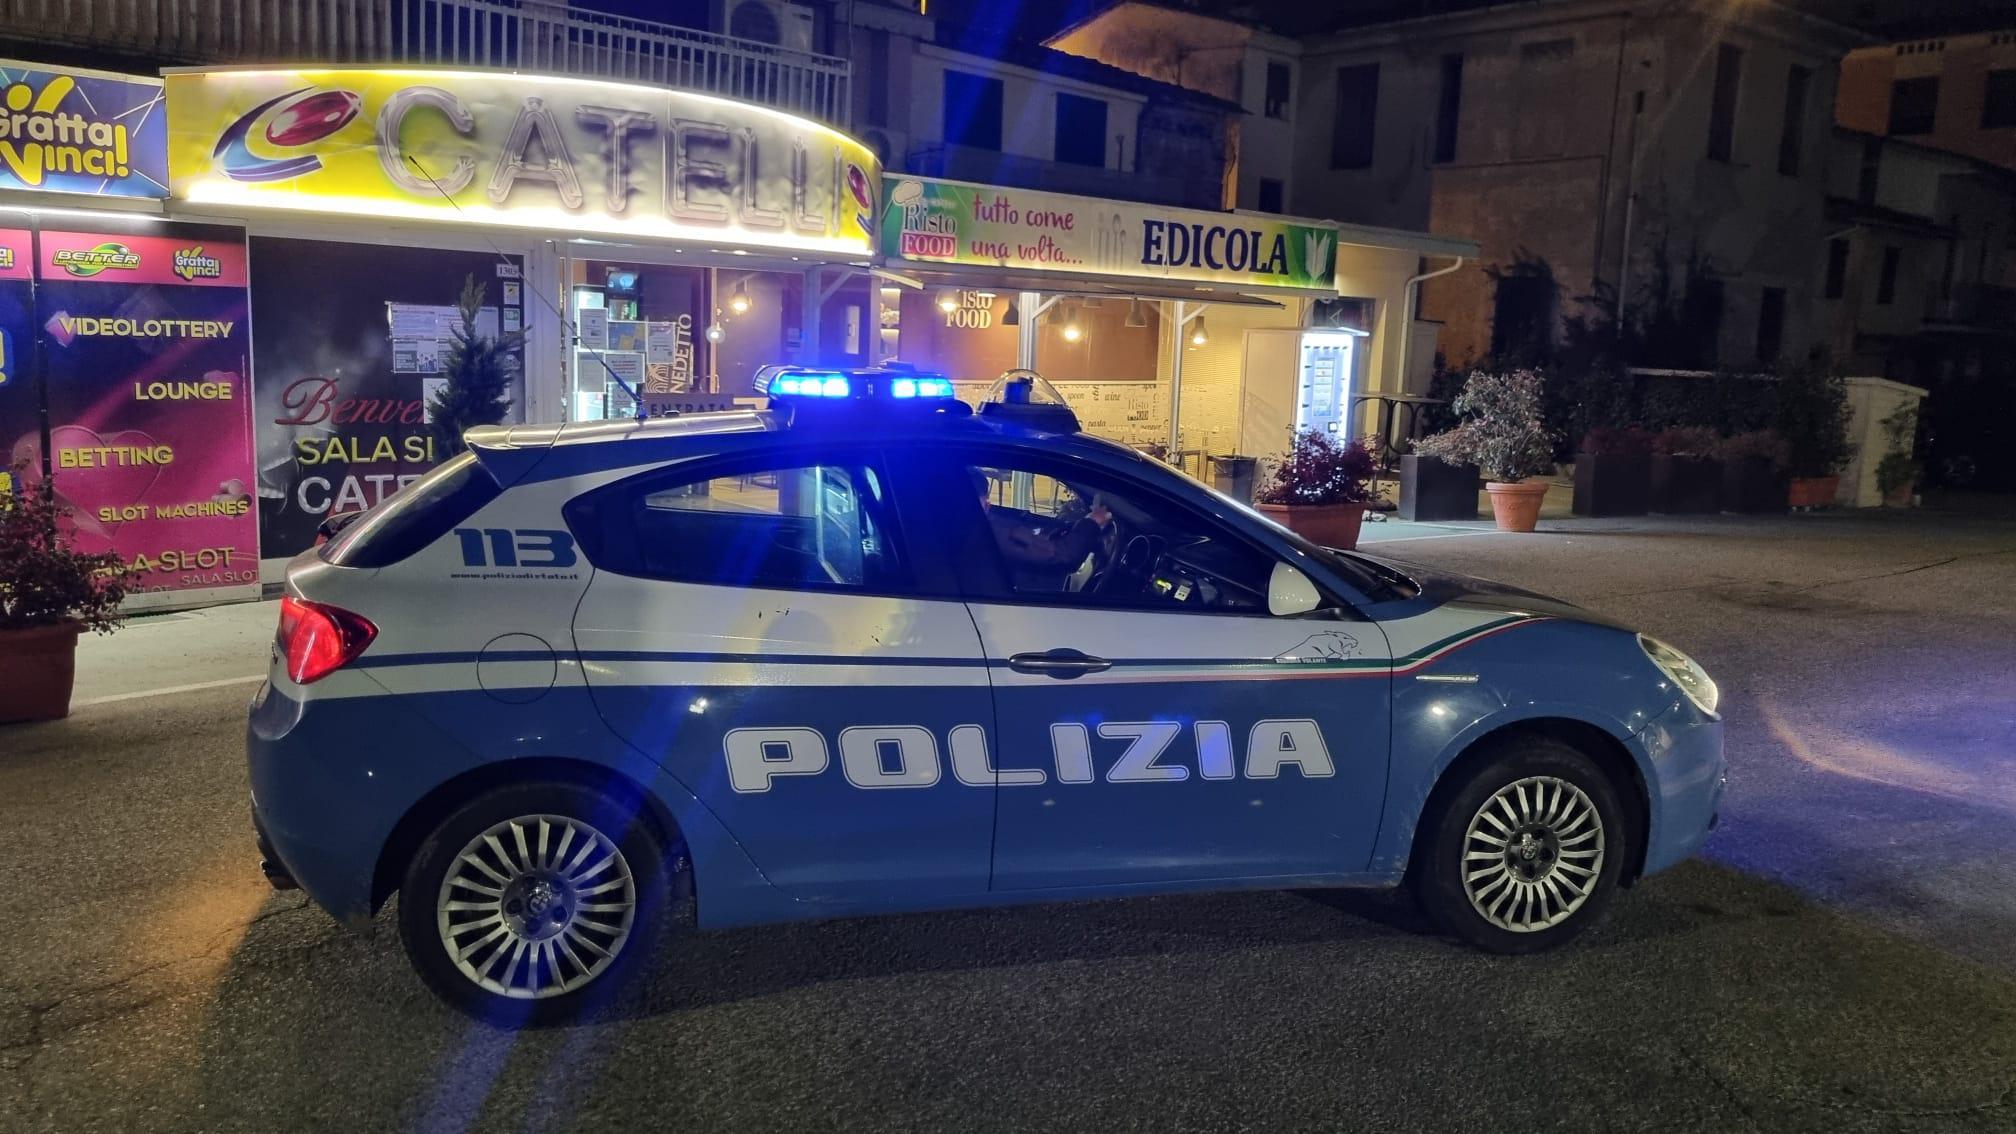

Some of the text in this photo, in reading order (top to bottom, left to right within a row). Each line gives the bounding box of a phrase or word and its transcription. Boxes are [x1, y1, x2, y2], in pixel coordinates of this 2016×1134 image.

[378, 85, 841, 235] CATELLI
[903, 203, 957, 234] Risto
[973, 192, 1075, 231] tutto come
[57, 250, 140, 264] BETTER
[903, 233, 956, 258] FOOD
[971, 234, 1084, 265] una volta...
[1141, 218, 1289, 276] EDICOLA
[176, 256, 215, 267] Gratta
[955, 289, 993, 309] isto
[58, 317, 234, 338] VIDEOLOTTERY
[135, 382, 233, 400] LOUNGE
[274, 377, 424, 426] Benve
[59, 445, 175, 468] BETTING
[297, 435, 397, 465] SALA
[99, 500, 250, 523] SLOT MACHINES
[158, 547, 235, 573] SLOT
[453, 528, 577, 568] 113
[181, 573, 220, 587] SALA
[722, 718, 1336, 794] POLIZIA
